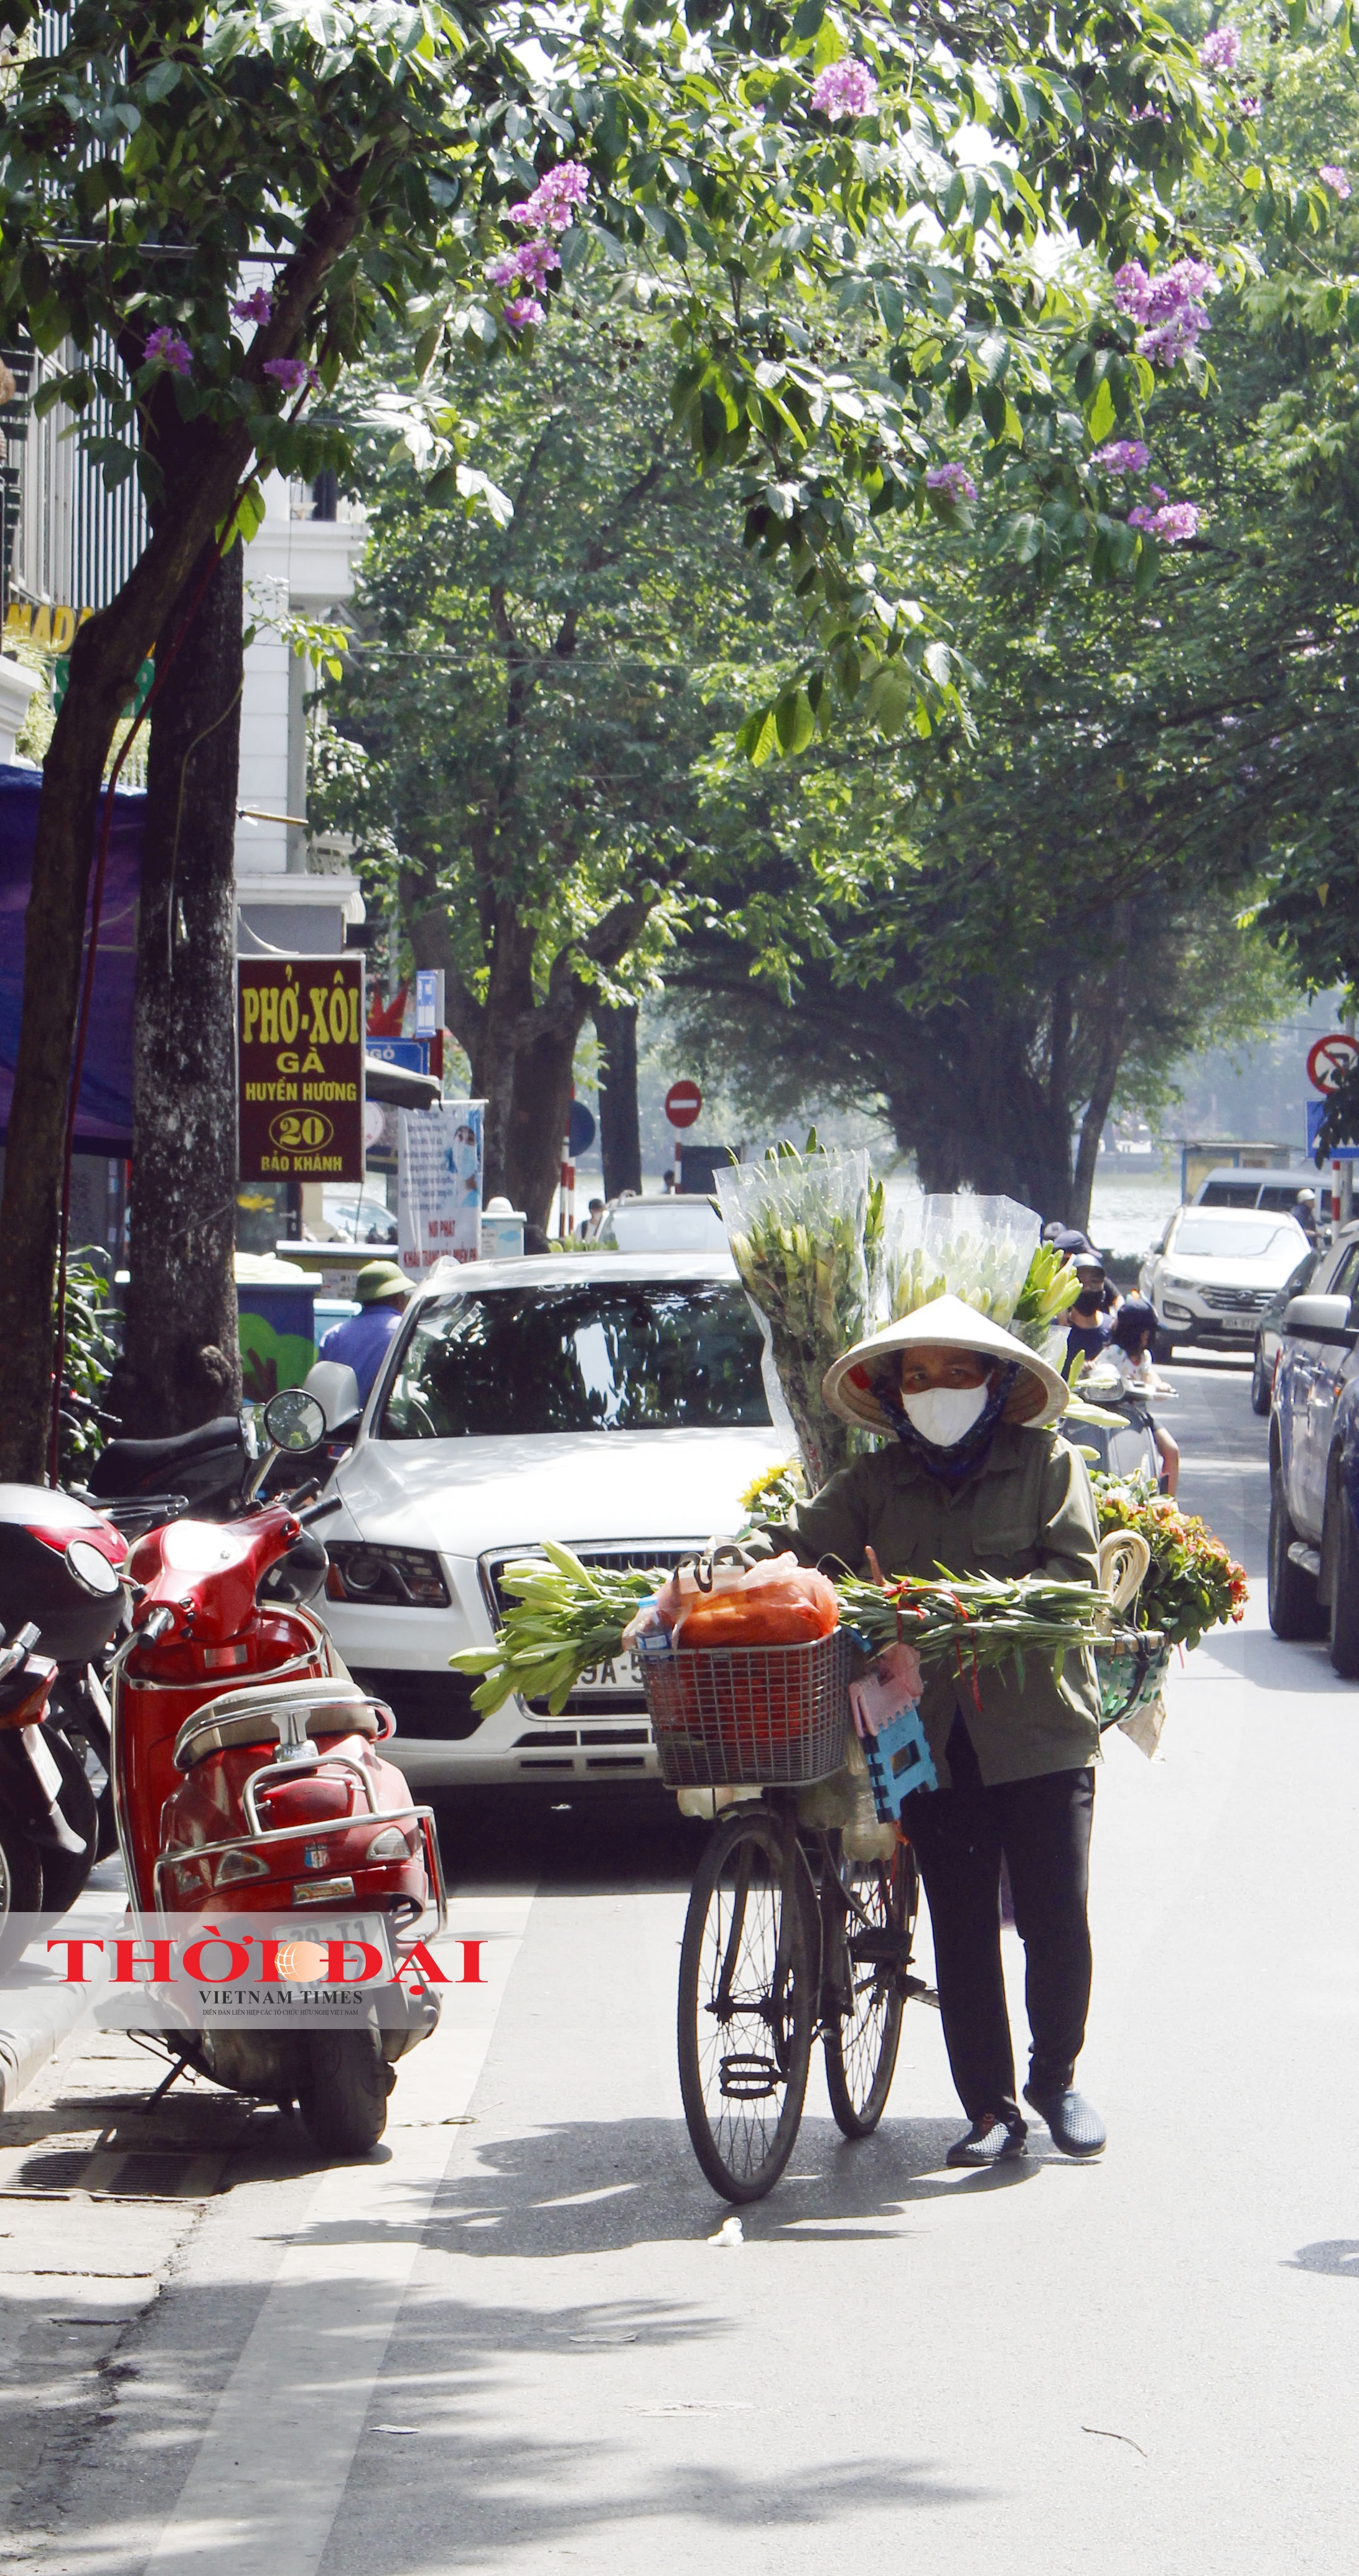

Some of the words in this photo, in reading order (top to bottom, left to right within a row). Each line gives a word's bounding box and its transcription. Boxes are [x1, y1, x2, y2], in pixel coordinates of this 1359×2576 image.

[276, 1046, 325, 1073] GÀ
[302, 1081, 357, 1101] HƯƠNG
[279, 1116, 324, 1146] 20
[261, 1150, 290, 1171] BẢO
[294, 1153, 343, 1172] KHÁNH
